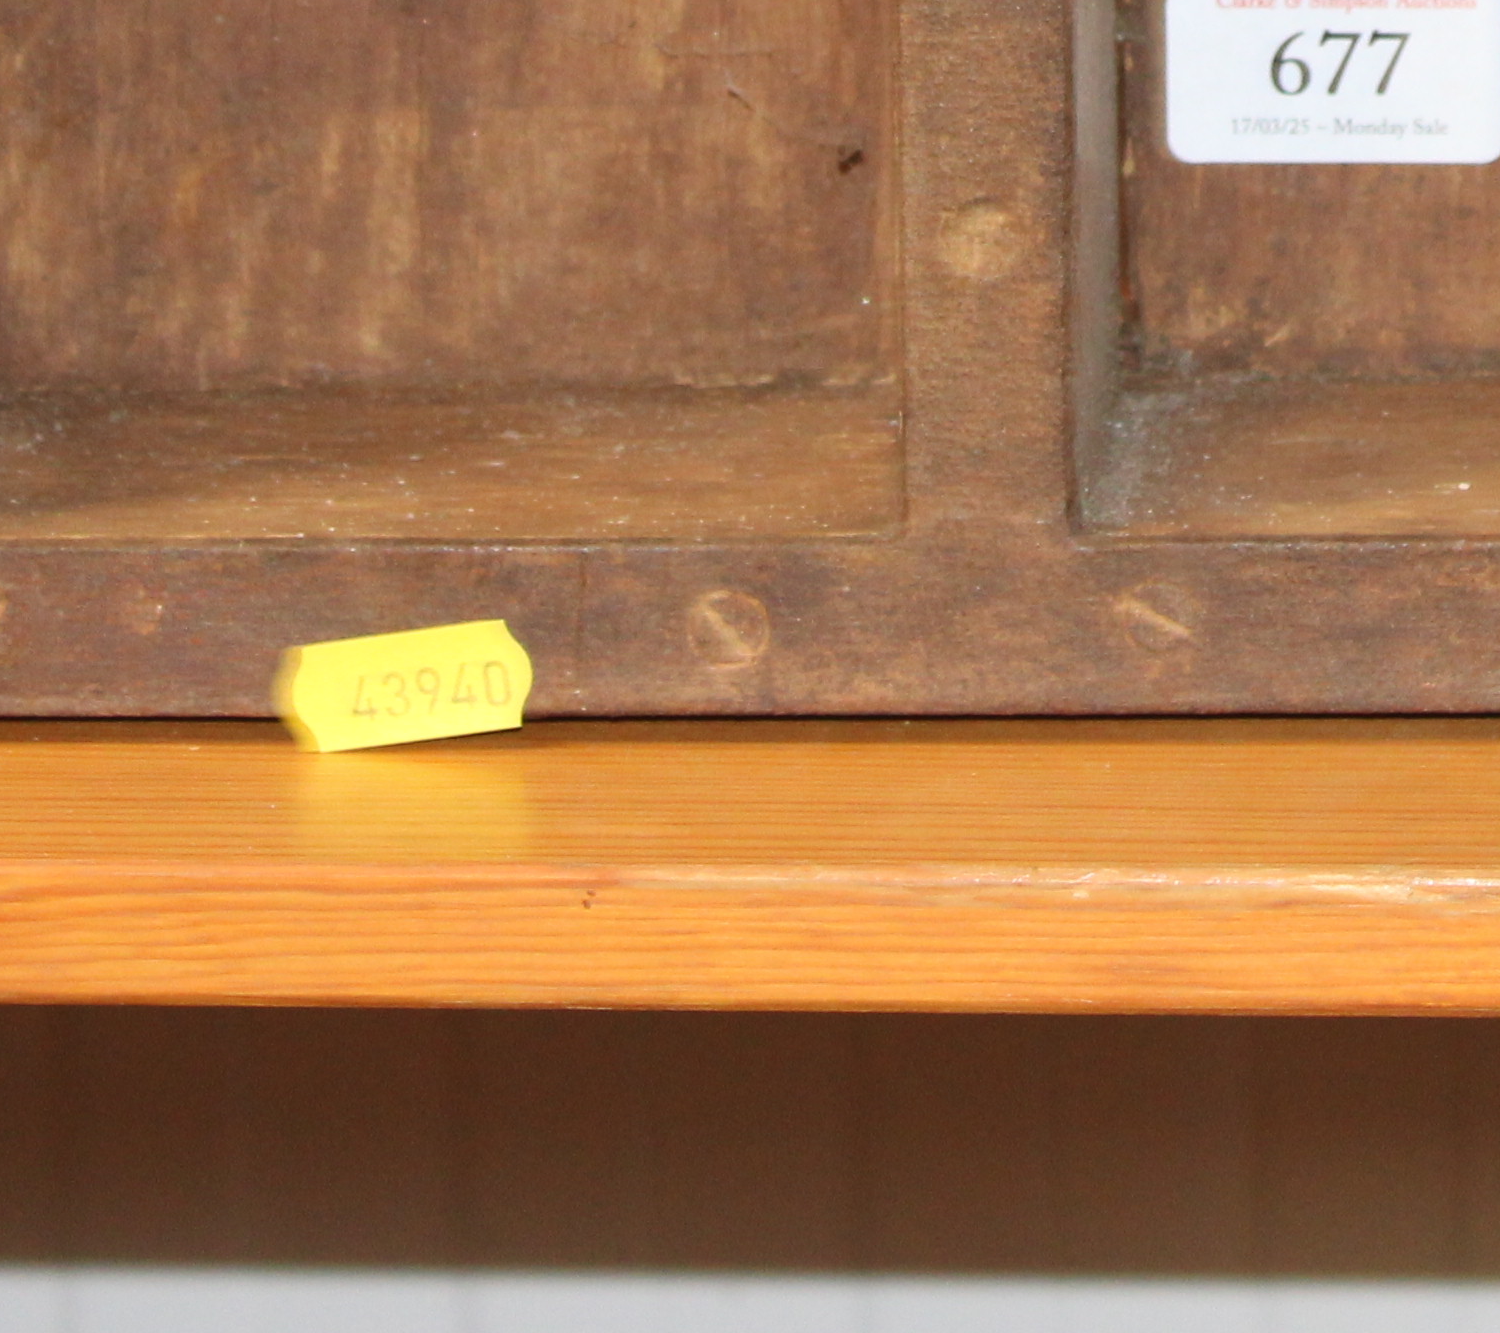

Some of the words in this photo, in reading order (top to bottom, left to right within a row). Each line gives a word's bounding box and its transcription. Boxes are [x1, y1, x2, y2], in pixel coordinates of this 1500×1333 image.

[1269, 29, 1411, 95] 677
[1333, 117, 1408, 140] Monday
[1413, 117, 1449, 135] Sale
[353, 660, 513, 720] 43940
